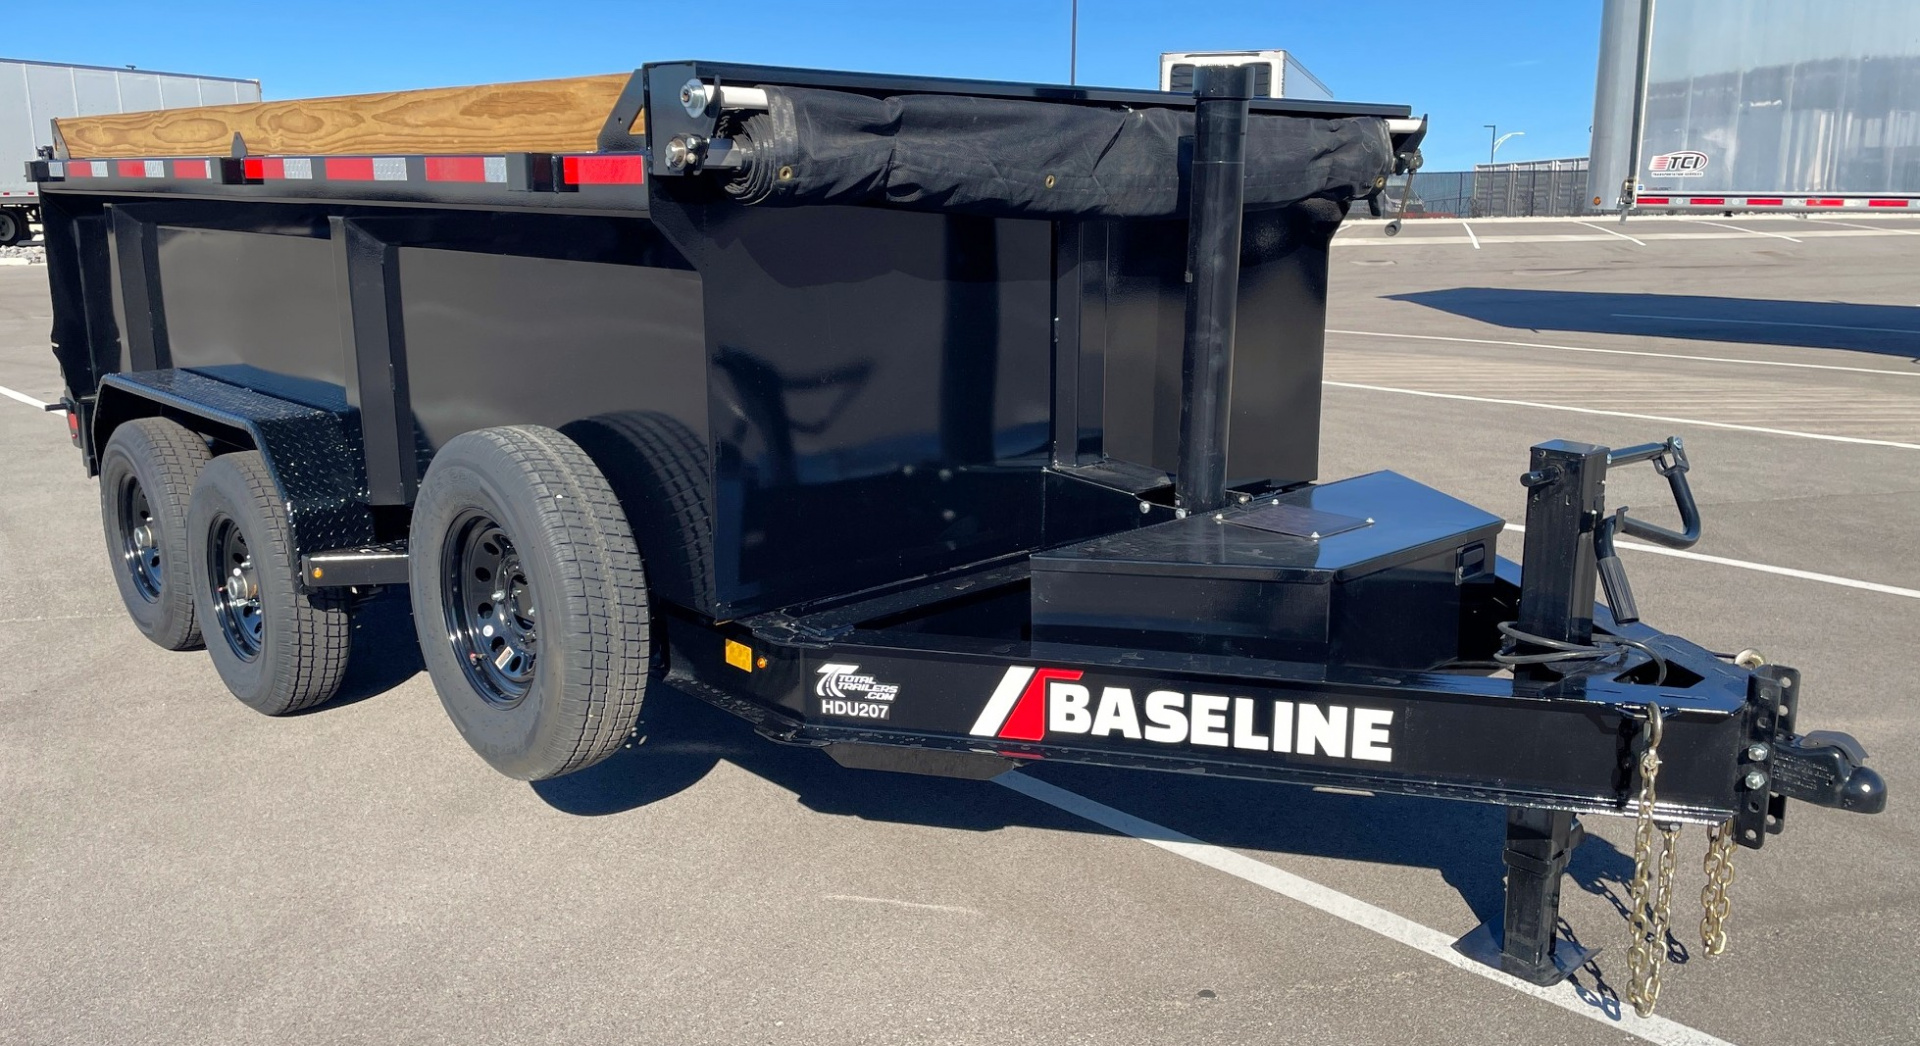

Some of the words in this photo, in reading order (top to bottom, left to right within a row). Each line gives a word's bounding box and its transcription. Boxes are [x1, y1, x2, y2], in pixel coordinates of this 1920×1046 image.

[1670, 156, 1701, 169] TCI
[838, 674, 877, 685] TOTAL
[837, 682, 899, 694] TRAILERS
[864, 691, 896, 701] .COM
[822, 699, 889, 719] HDU207
[1049, 682, 1394, 763] BASELINE
